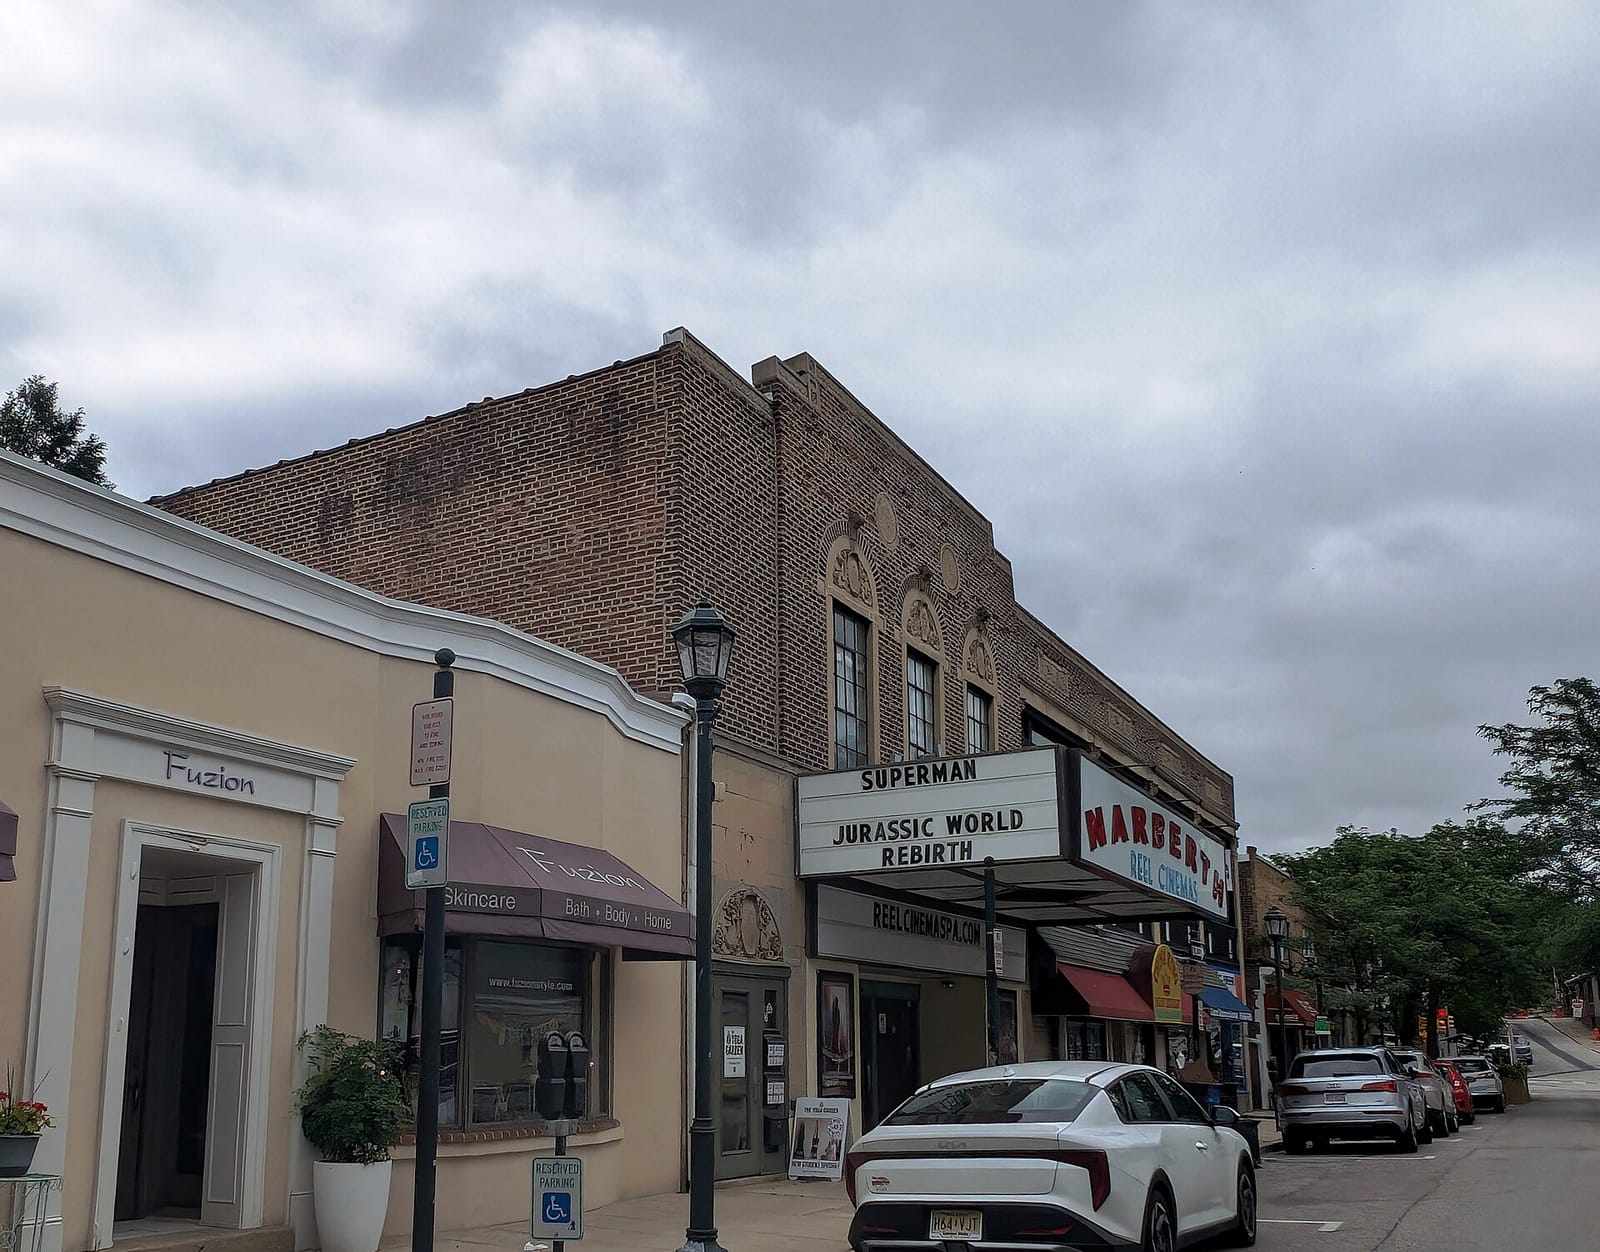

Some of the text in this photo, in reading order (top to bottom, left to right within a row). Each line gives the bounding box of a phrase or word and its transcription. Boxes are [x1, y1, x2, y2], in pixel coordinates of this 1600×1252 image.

[163, 750, 255, 795] Fuzion
[861, 759, 977, 791] SUPERMAN
[411, 805, 447, 820] RESERVED
[414, 820, 443, 832] PARKING
[833, 809, 1023, 846] JURASSIC WORLD
[516, 846, 645, 891] Fuzion
[882, 840, 973, 867] REBIRTH
[1084, 804, 1225, 908] NARBERTH
[1130, 850, 1198, 903] REEL CINEMAS
[444, 887, 516, 910] Skincare
[565, 898, 672, 930] Bath Body Home
[535, 1162, 579, 1175] RESERVED
[539, 1177, 575, 1189] PARKING
